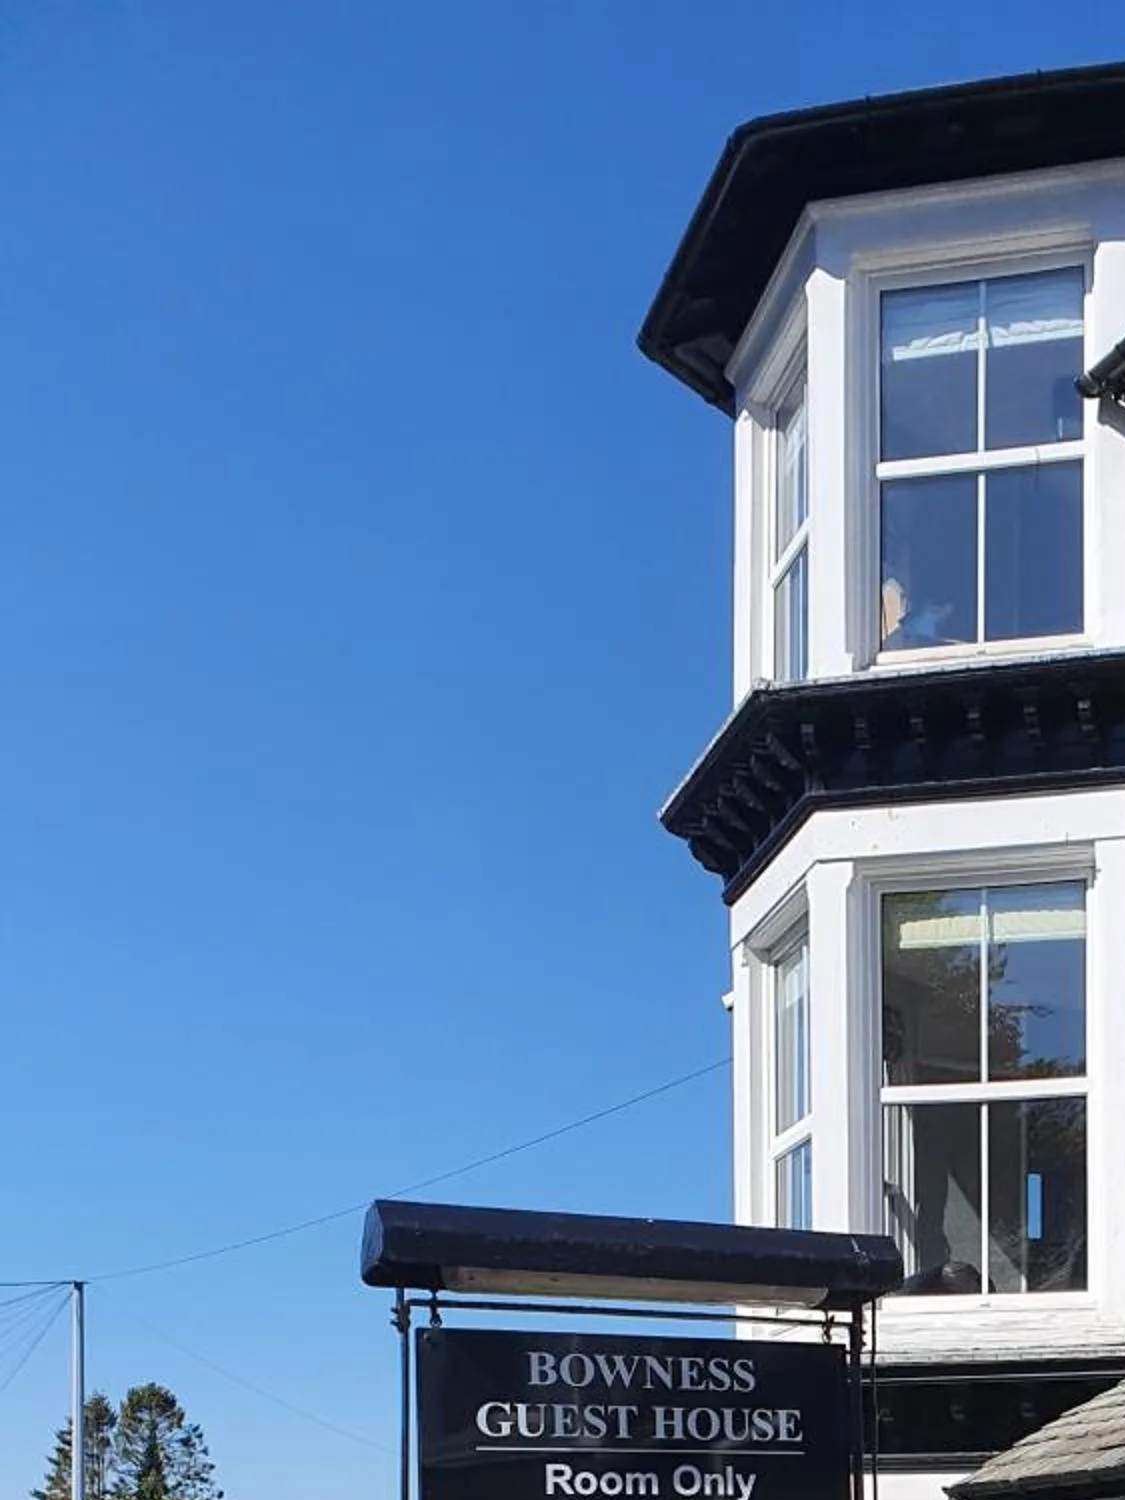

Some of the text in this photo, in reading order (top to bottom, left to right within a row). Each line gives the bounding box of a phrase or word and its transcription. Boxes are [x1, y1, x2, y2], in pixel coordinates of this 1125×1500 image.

[528, 1351, 756, 1393] BOWNESS
[476, 1402, 803, 1442] GUEST HOUSE
[545, 1464, 659, 1496] Room
